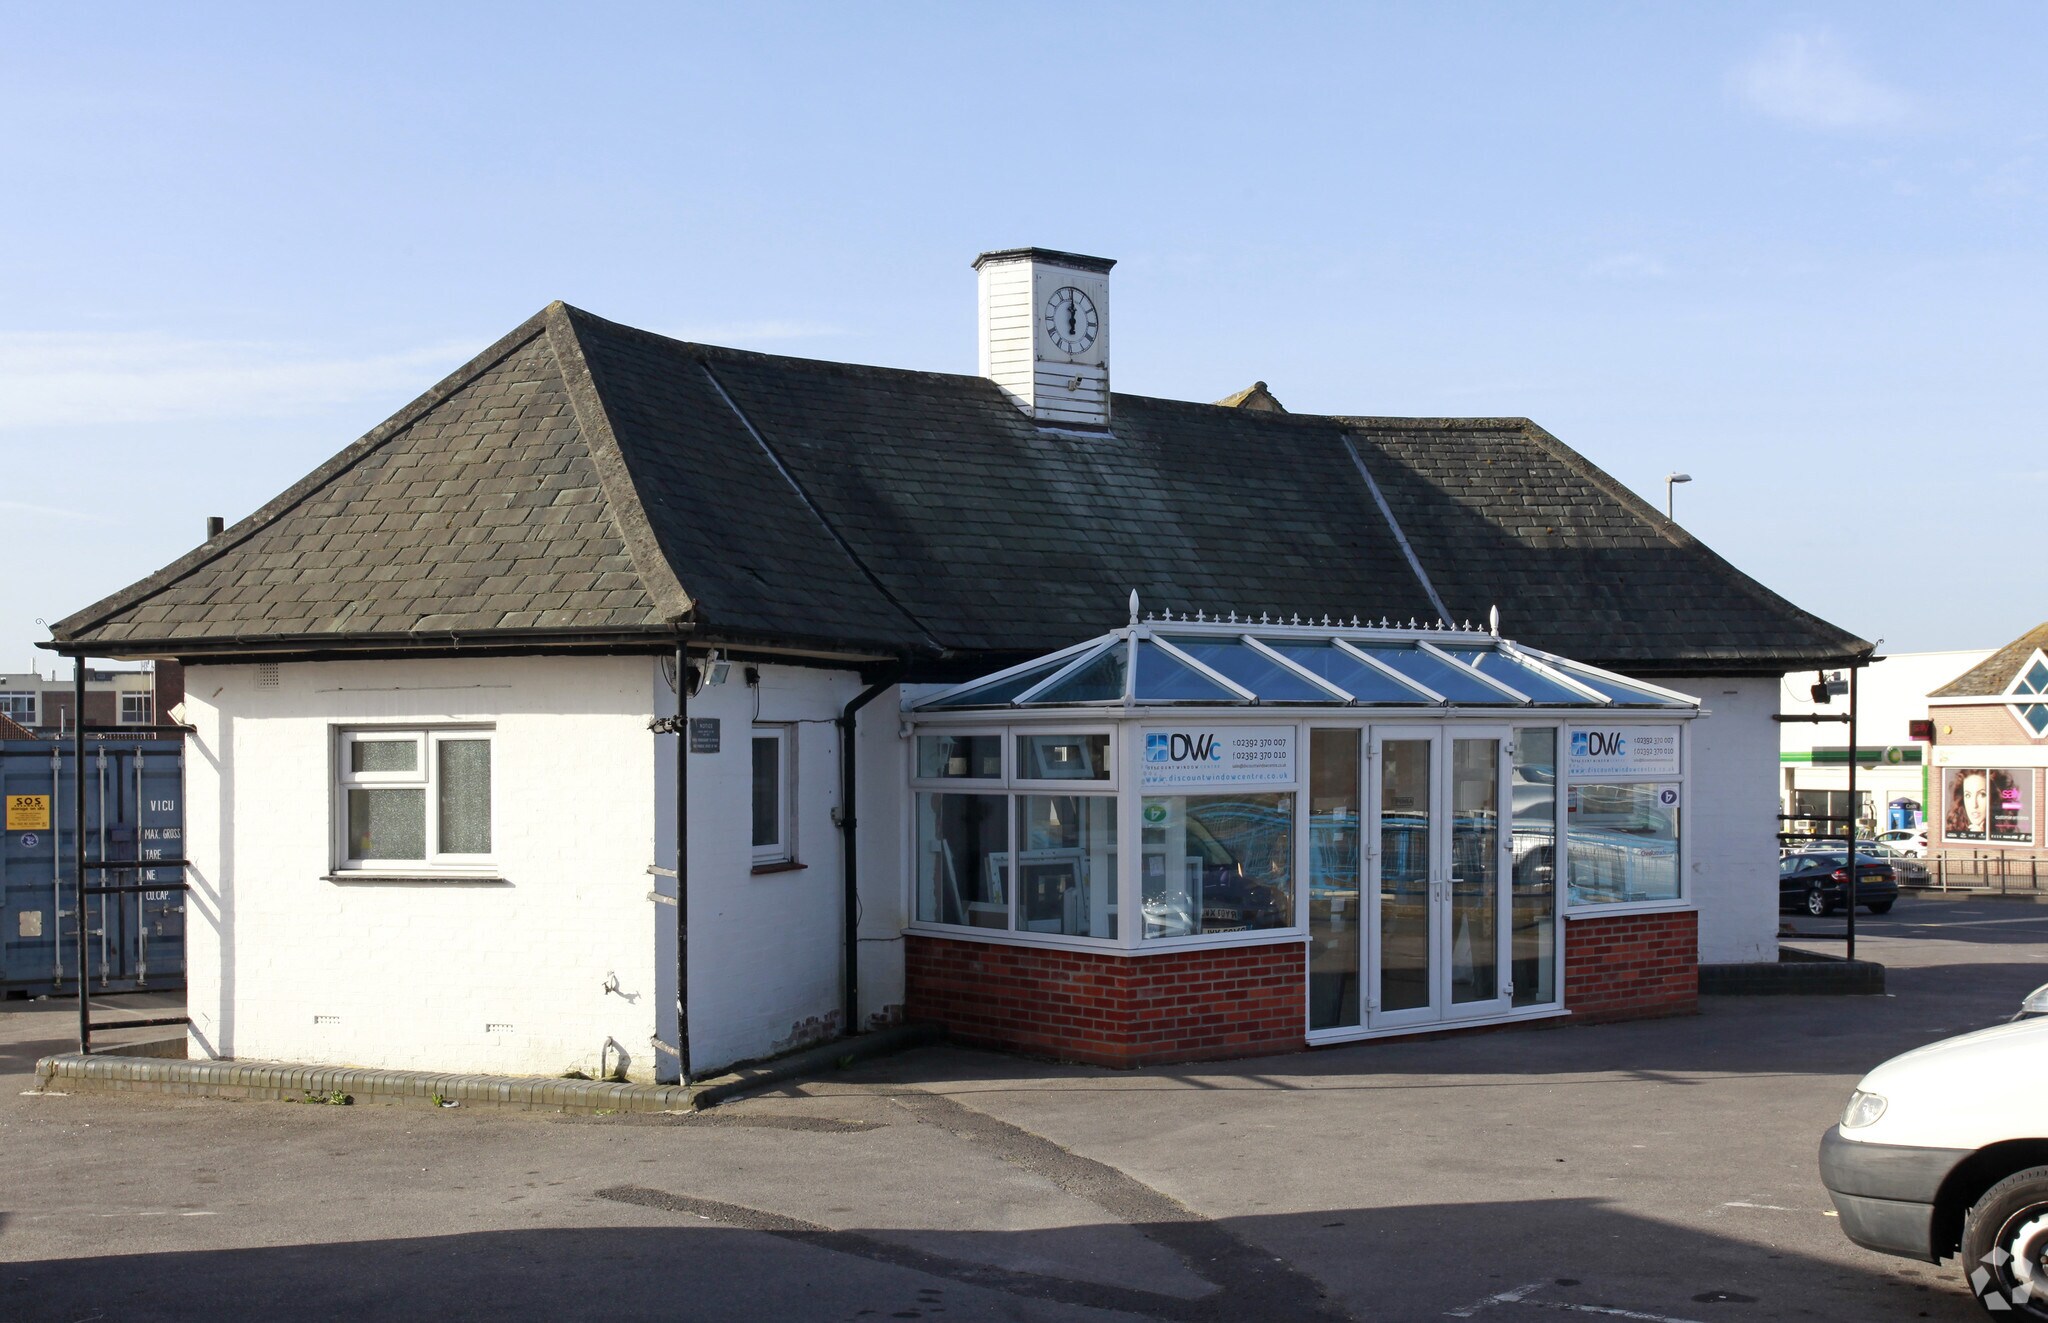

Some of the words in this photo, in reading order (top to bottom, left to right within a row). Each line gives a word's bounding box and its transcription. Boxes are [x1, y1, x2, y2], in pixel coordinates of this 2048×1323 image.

[1259, 738, 1272, 747] 370
[1273, 738, 1287, 746] 007
[1653, 737, 1663, 745] 370
[1259, 751, 1272, 760] 370
[1273, 751, 1287, 759] 010
[1653, 748, 1663, 756] 370
[1145, 772, 1288, 783] www.discountwindowcentre.co.uk
[150, 800, 174, 811] VICU
[144, 829, 161, 840] MAX.
[163, 828, 181, 839] GROSS
[145, 849, 162, 860] TARE
